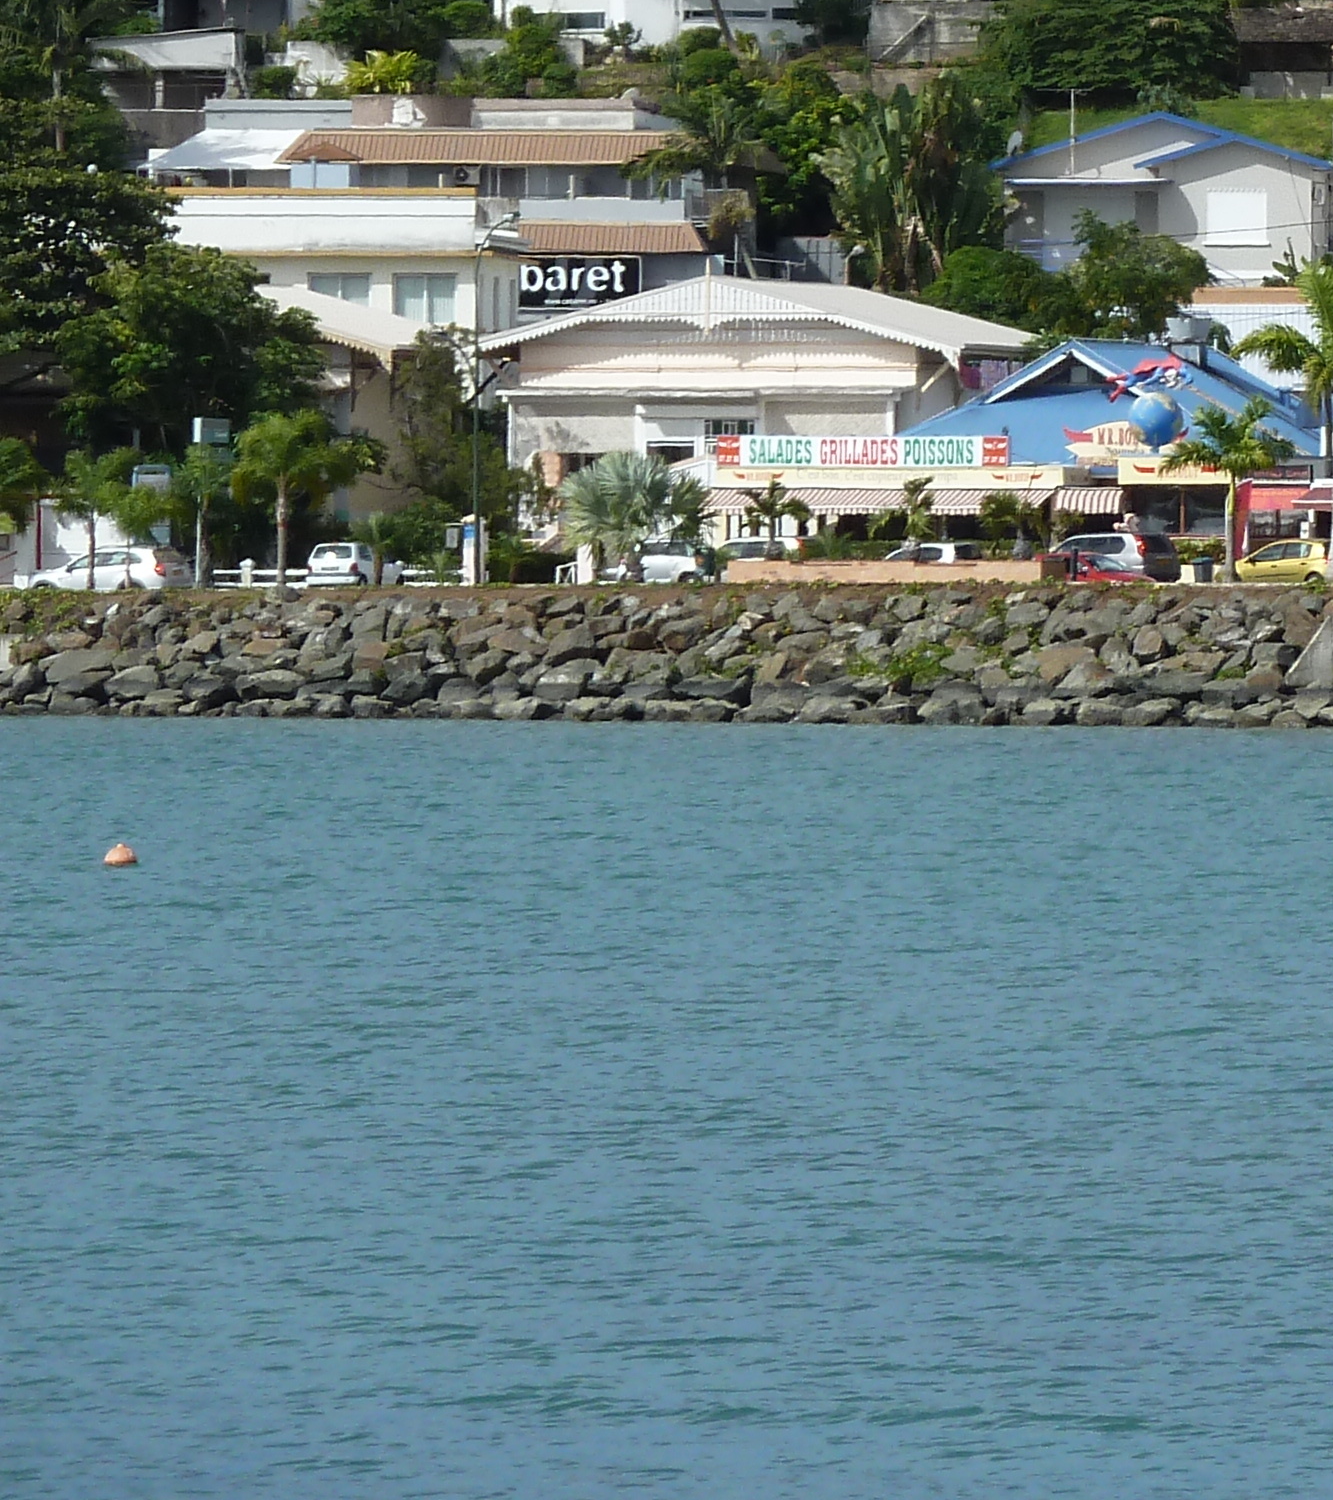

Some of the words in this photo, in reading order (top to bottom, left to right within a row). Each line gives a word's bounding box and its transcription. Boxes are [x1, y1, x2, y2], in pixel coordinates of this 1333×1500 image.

[748, 438, 813, 465] SALADES
[819, 438, 899, 465] GRILLADES
[903, 438, 975, 465] POISSONS
